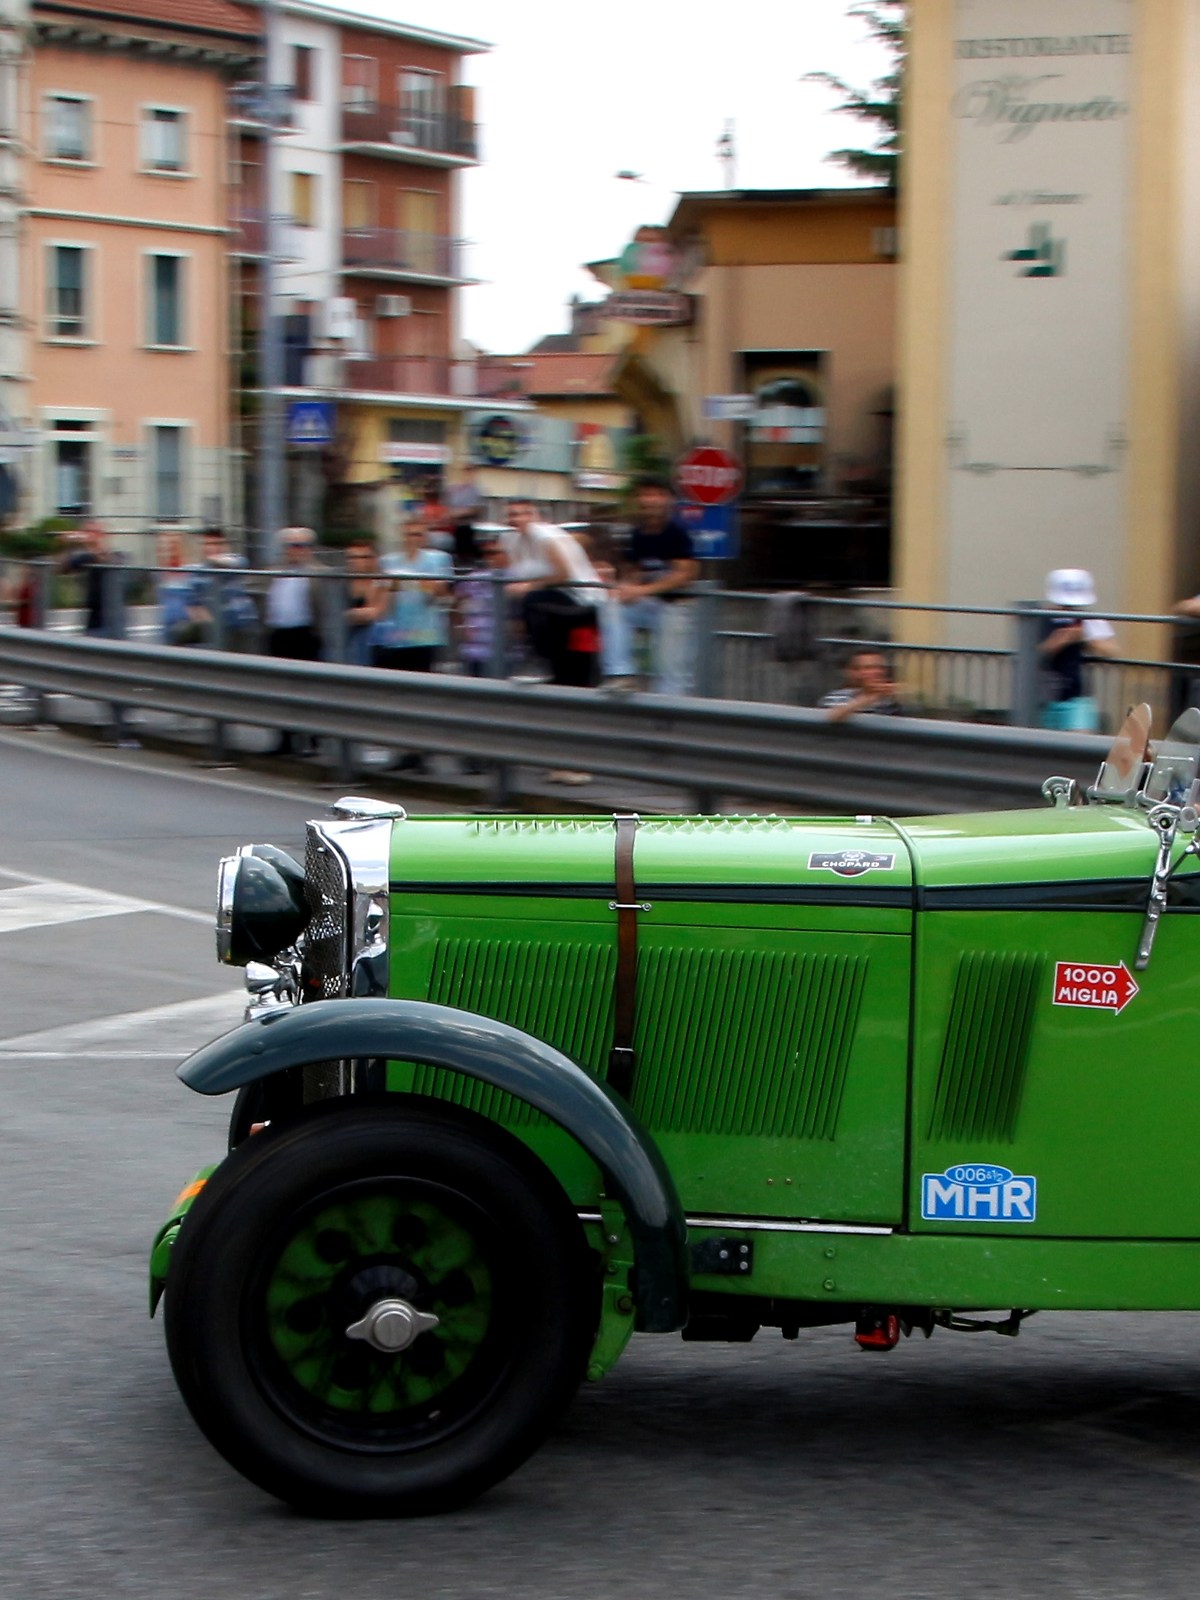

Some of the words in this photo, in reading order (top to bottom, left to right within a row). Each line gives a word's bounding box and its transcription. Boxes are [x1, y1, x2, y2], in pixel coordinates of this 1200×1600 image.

[955, 34, 1131, 59] RISTORANTE
[680, 464, 740, 488] STOP
[1063, 967, 1117, 985] 1000
[1057, 986, 1118, 1005] MIGLIA
[926, 1178, 1033, 1218] MHR
